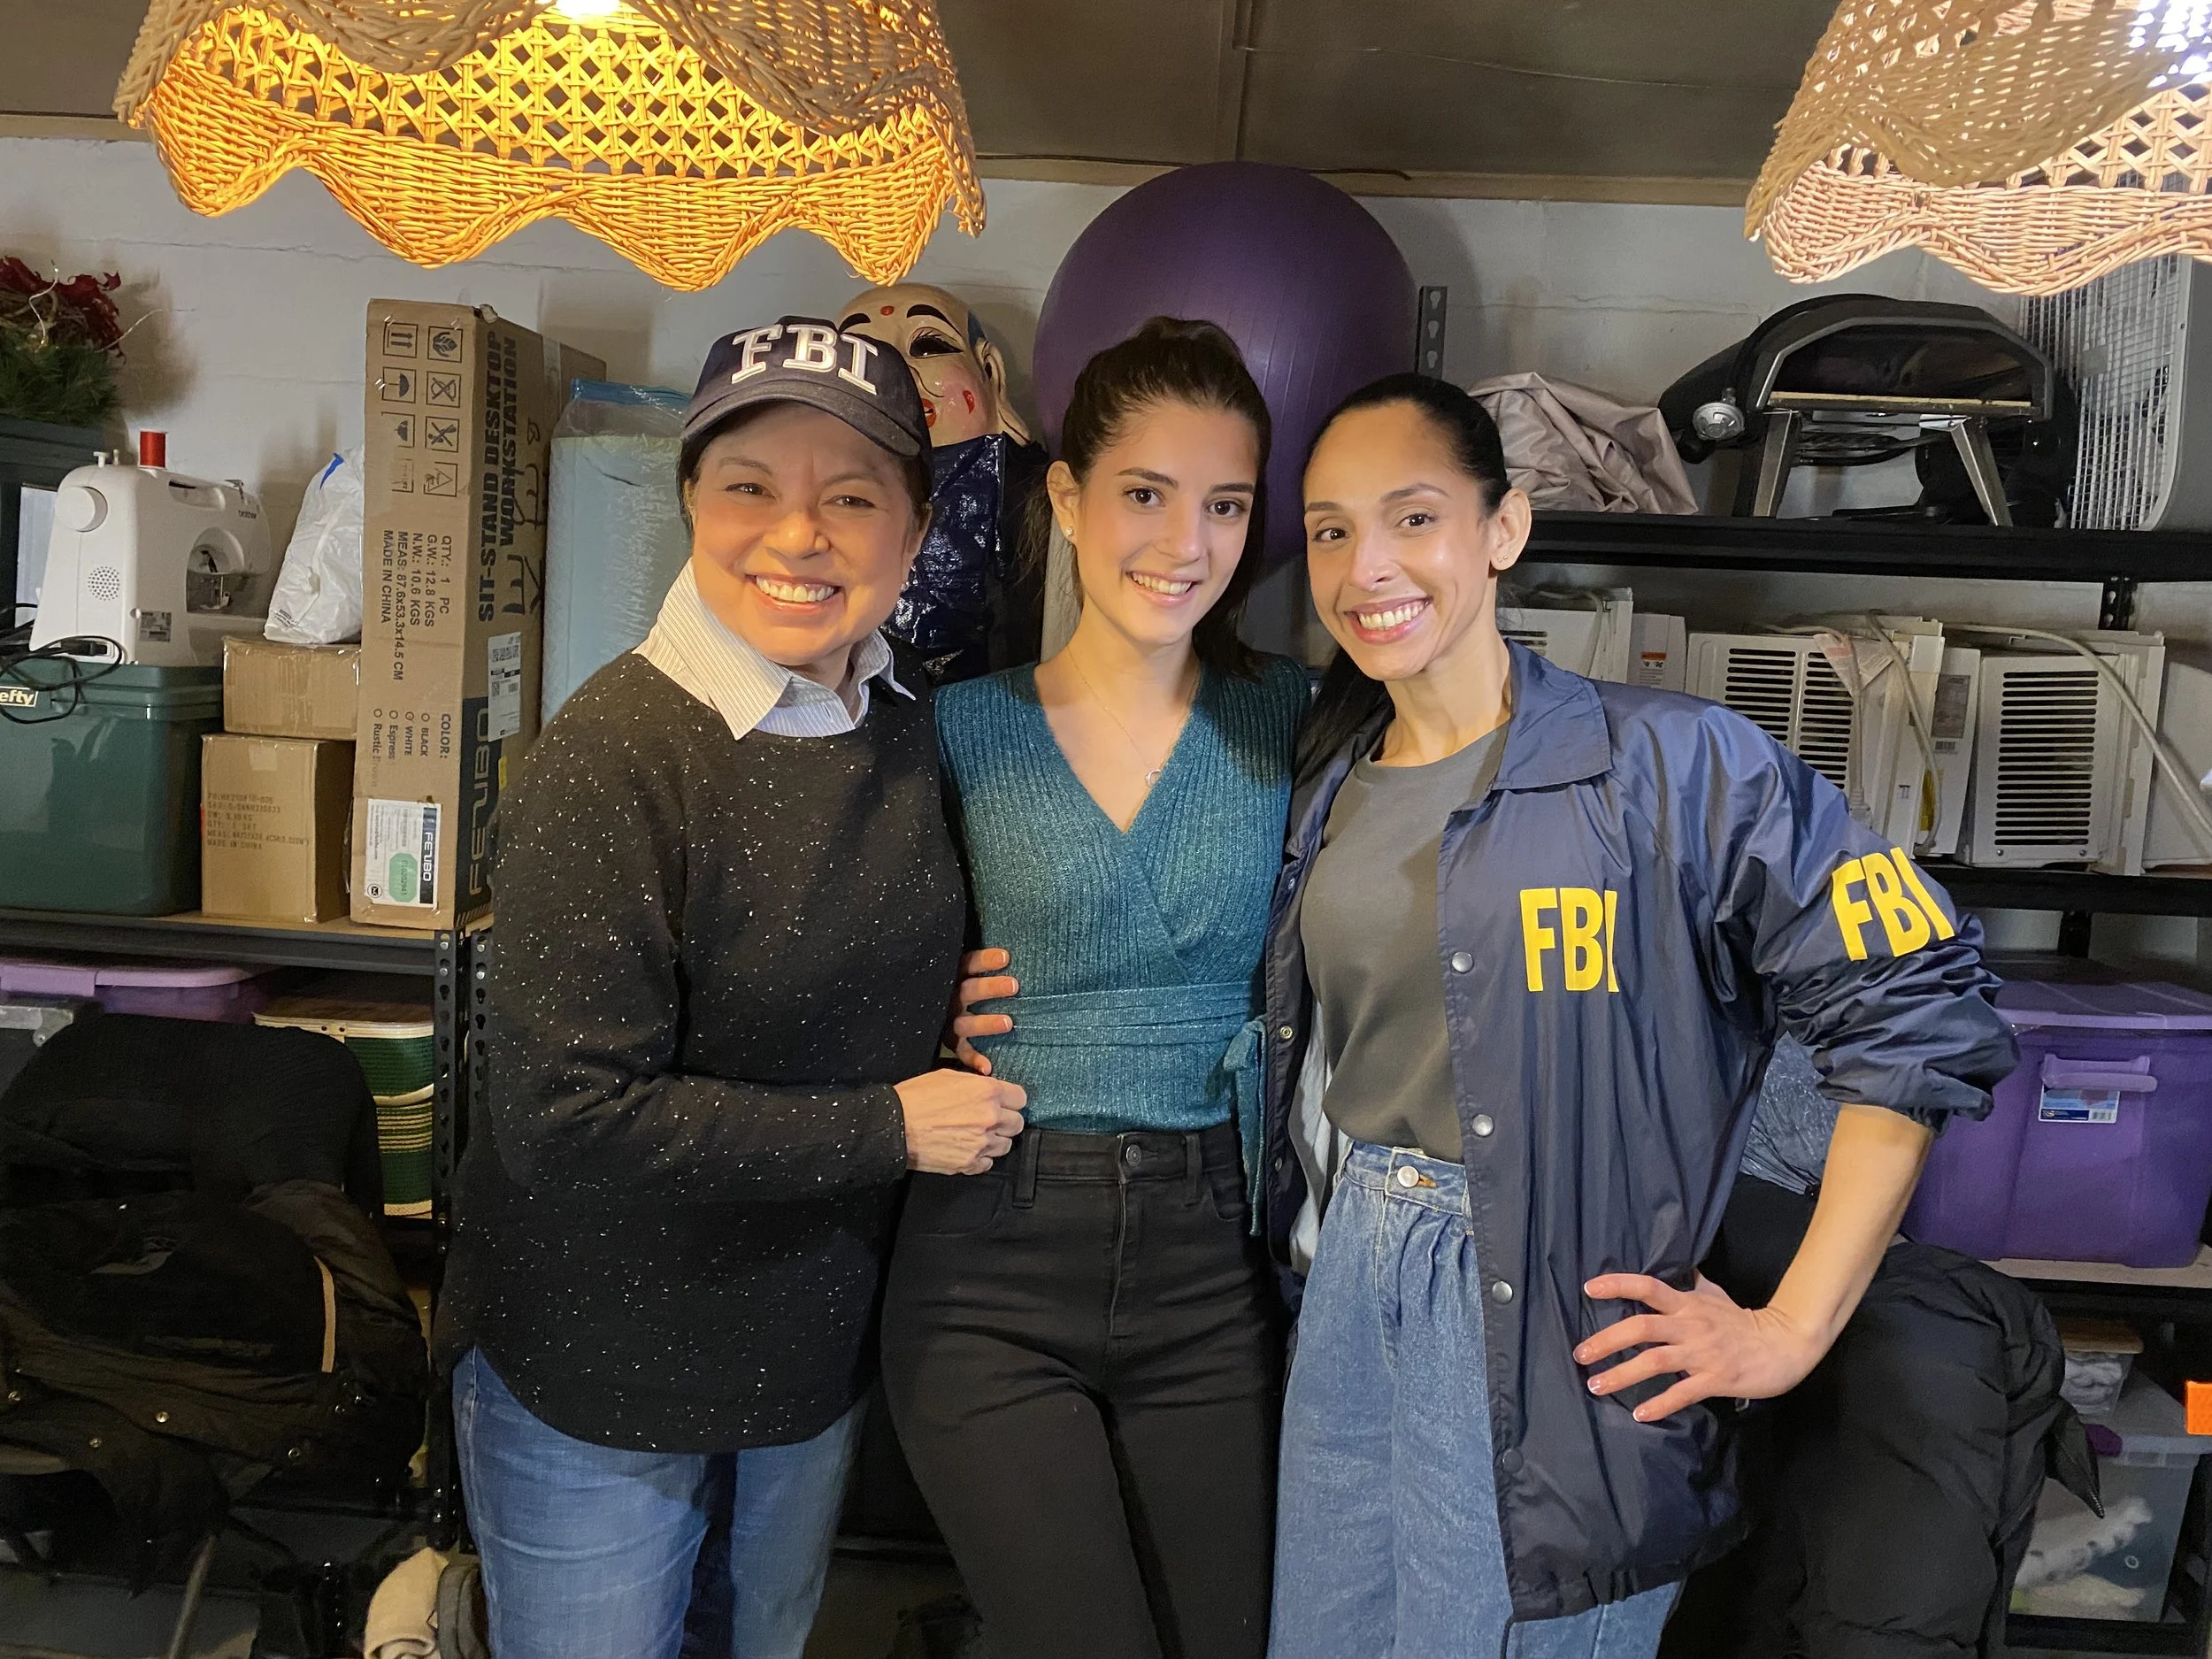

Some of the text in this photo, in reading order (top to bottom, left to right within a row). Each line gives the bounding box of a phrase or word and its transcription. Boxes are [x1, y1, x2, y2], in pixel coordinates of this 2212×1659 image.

[732, 324, 879, 396] FBI
[479, 331, 503, 622] SIT-STAND DESKTOP
[499, 336, 518, 547] WORKSTATION
[380, 530, 394, 624] MADE IN CHINA
[393, 531, 409, 681] MEAS: 87.6x53.3x14.5 CM
[410, 533, 423, 626] N.W.: 10.6 KGS
[424, 534, 438, 627] G.W.: 12.8 KGS
[439, 597, 450, 615] PC
[373, 723, 383, 754] Rustic
[387, 724, 398, 764] Espress
[404, 726, 413, 757] WHITE
[420, 727, 429, 757] BLACK
[439, 713, 451, 759] COLOR:
[207, 838, 227, 848] MADE
[241, 841, 262, 850] CHINA
[1519, 887, 1620, 993] FBI
[1832, 847, 1955, 962] FBI
